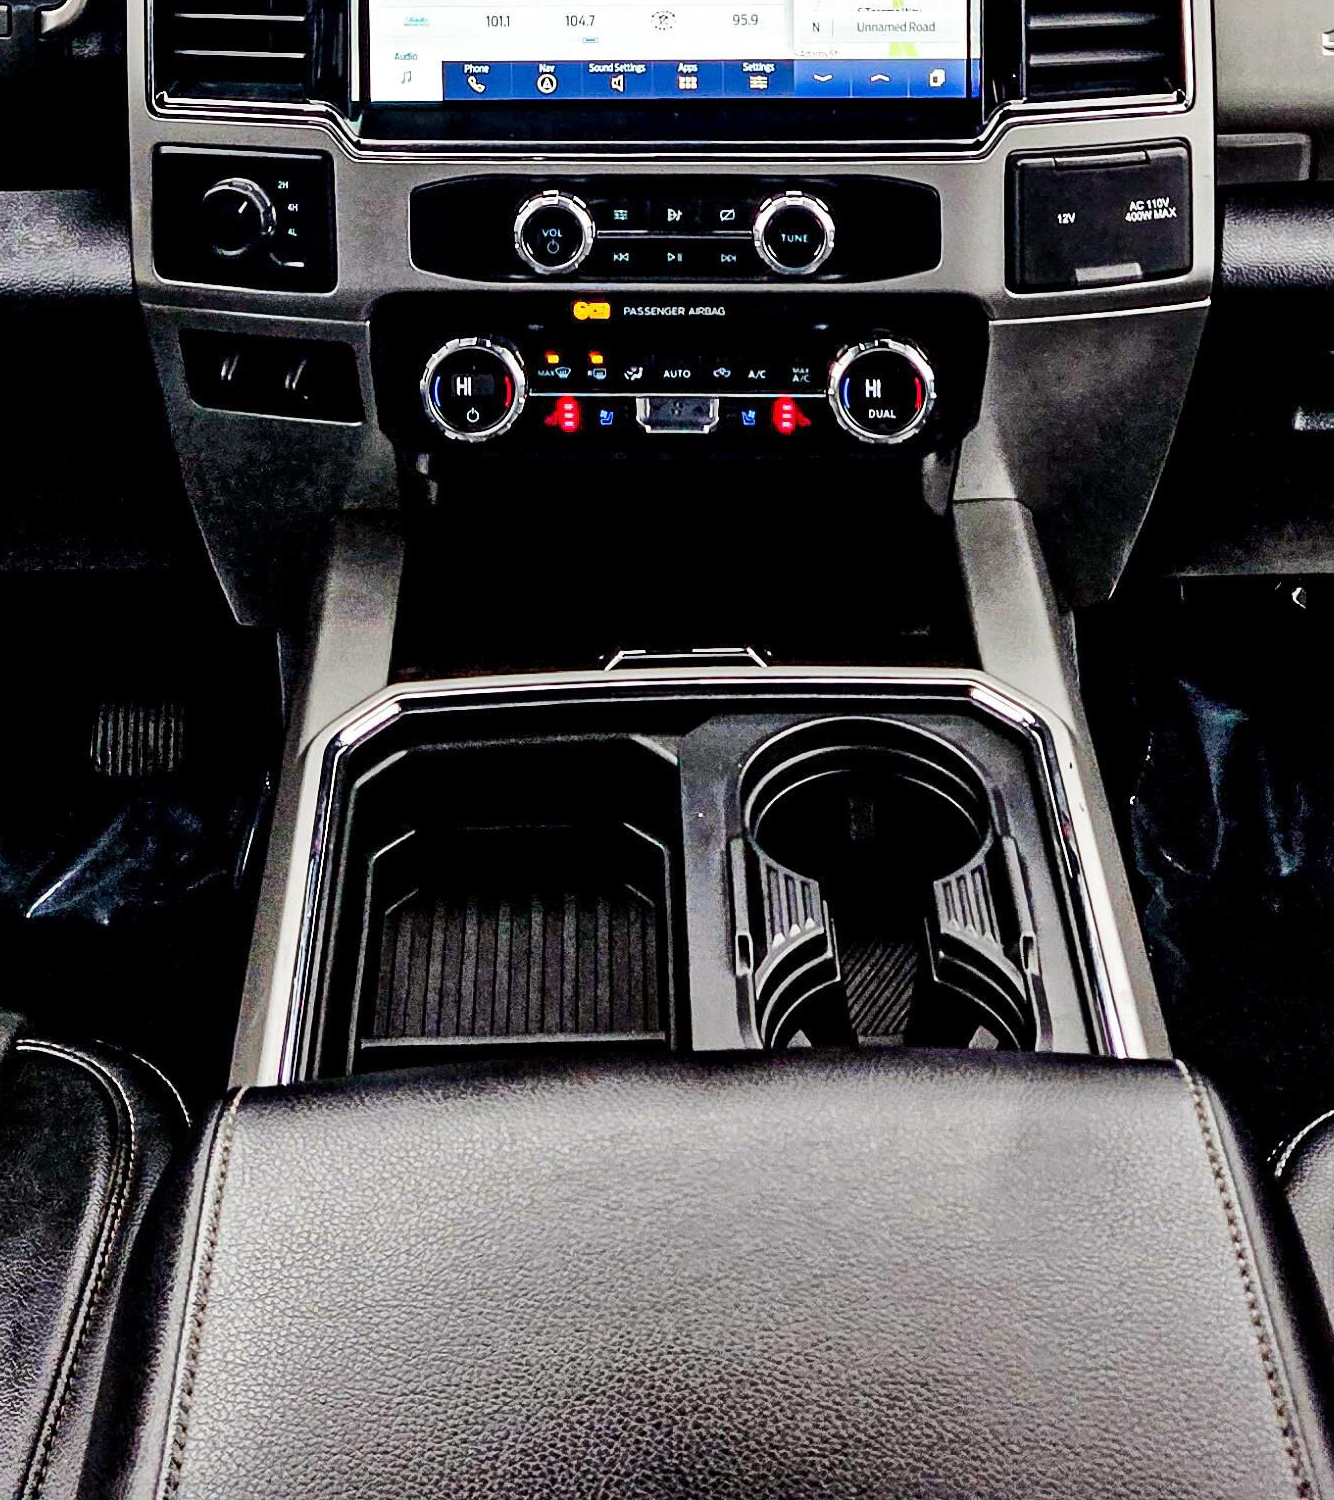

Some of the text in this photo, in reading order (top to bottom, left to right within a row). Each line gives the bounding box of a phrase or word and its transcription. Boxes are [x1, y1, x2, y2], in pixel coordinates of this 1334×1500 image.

[486, 15, 510, 27] 101.1
[565, 15, 595, 27] 104.7
[732, 14, 759, 26] 95.9
[812, 22, 820, 33] N
[857, 21, 936, 33] Unnamed Road
[394, 52, 418, 61] Audio
[464, 63, 490, 74] Phone
[538, 64, 555, 73] Nav
[588, 63, 647, 74] Sound Settings
[677, 62, 698, 74] Apps
[742, 62, 776, 74] Settings
[277, 181, 289, 190] 2H
[287, 203, 299, 213] 4H
[1129, 197, 1170, 212] AC 110V
[1057, 212, 1076, 224] 12V
[1124, 207, 1177, 223] 400W MAX
[542, 228, 563, 238] VOL
[780, 233, 809, 243] TUNE
[623, 306, 726, 316] PASSENGER AIRBAG
[663, 369, 691, 379] AUTO
[747, 369, 767, 380] A/C
[792, 374, 811, 383] A/C
[456, 376, 472, 397] HI
[865, 378, 882, 399] HI
[868, 409, 897, 419] DUAL
